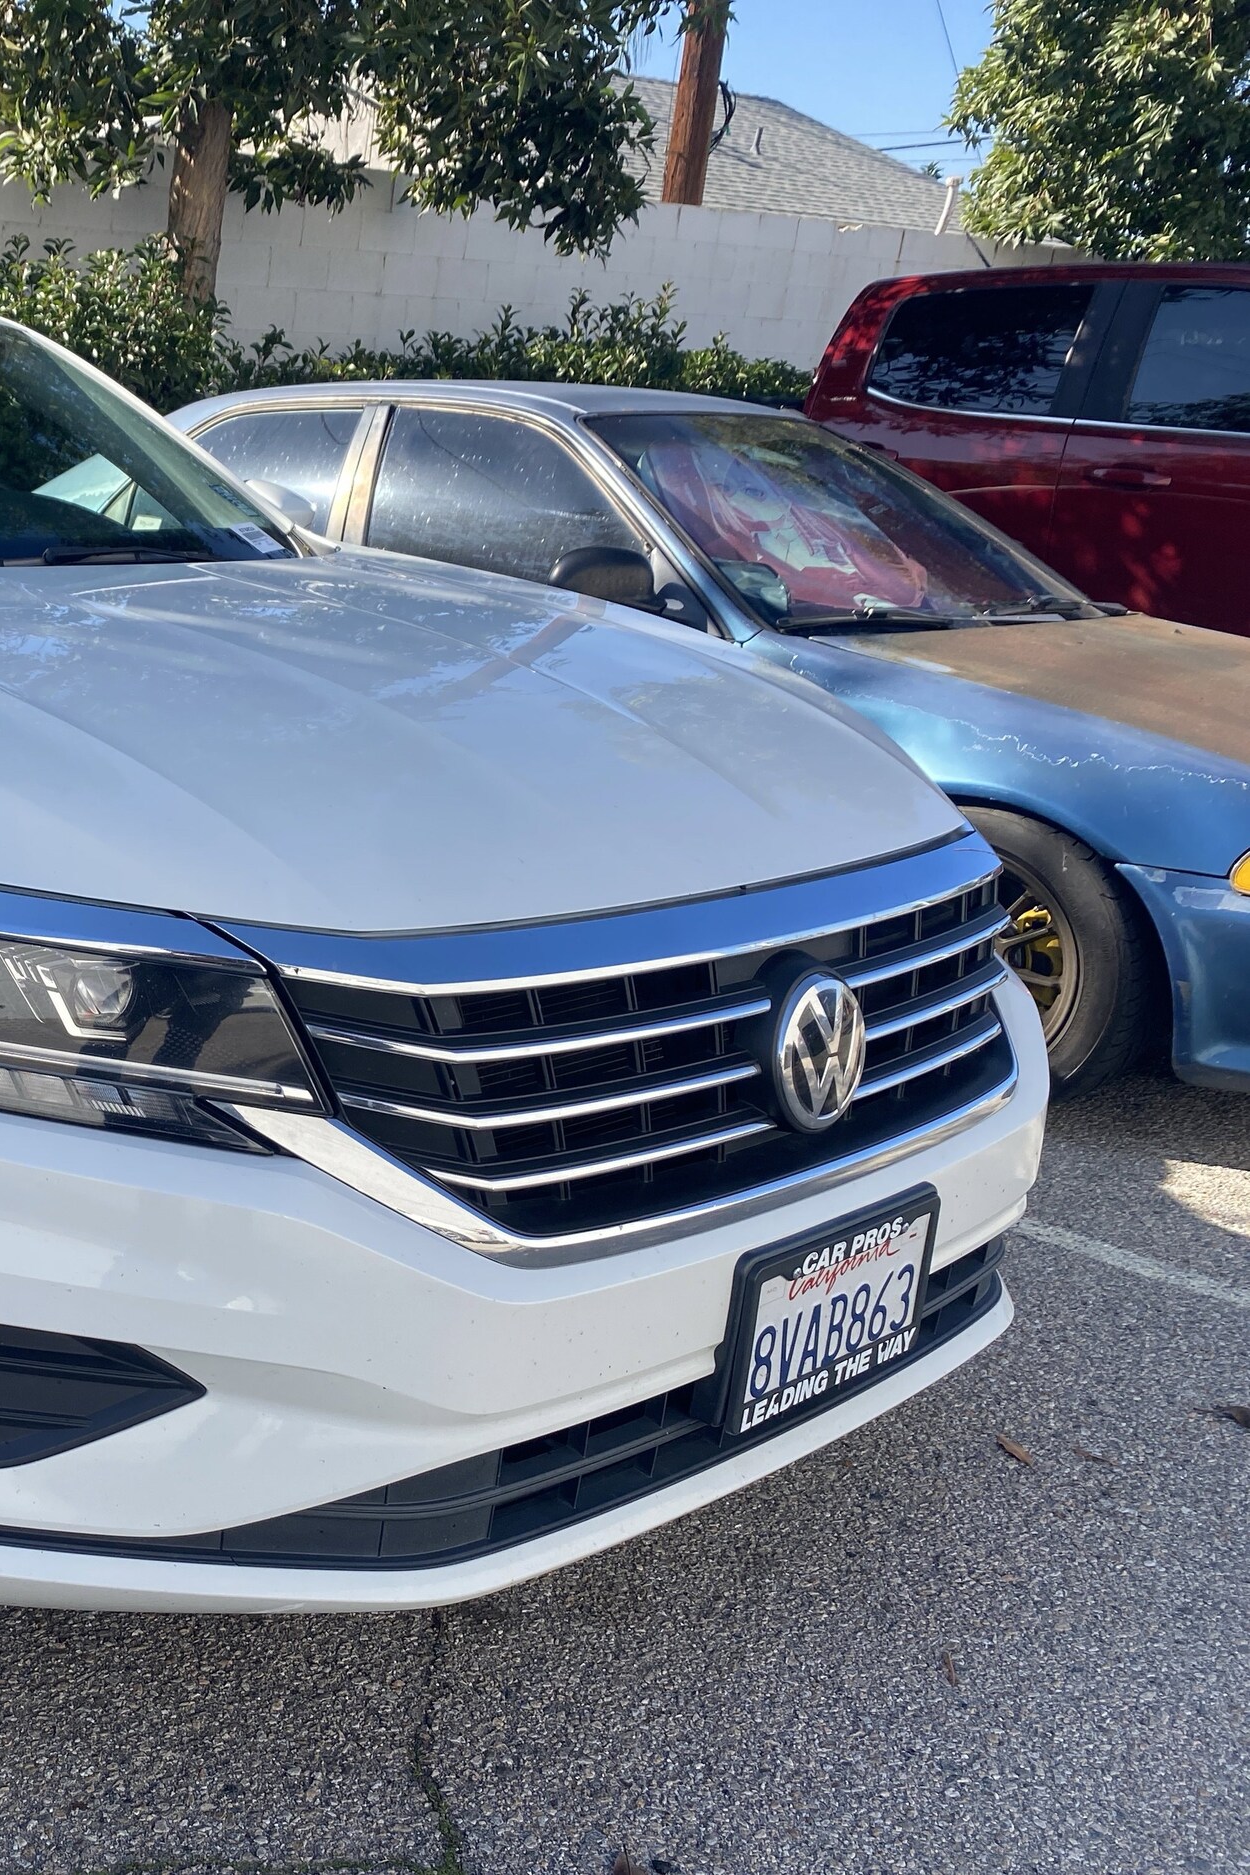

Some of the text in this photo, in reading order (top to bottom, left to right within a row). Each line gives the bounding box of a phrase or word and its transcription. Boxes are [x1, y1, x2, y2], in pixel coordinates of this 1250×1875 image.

[788, 1239, 901, 1301] California
[802, 1216, 904, 1275] CAR PROS
[750, 1263, 915, 1399] 8VAB863
[740, 1326, 917, 1433] LEADING THE WAY
